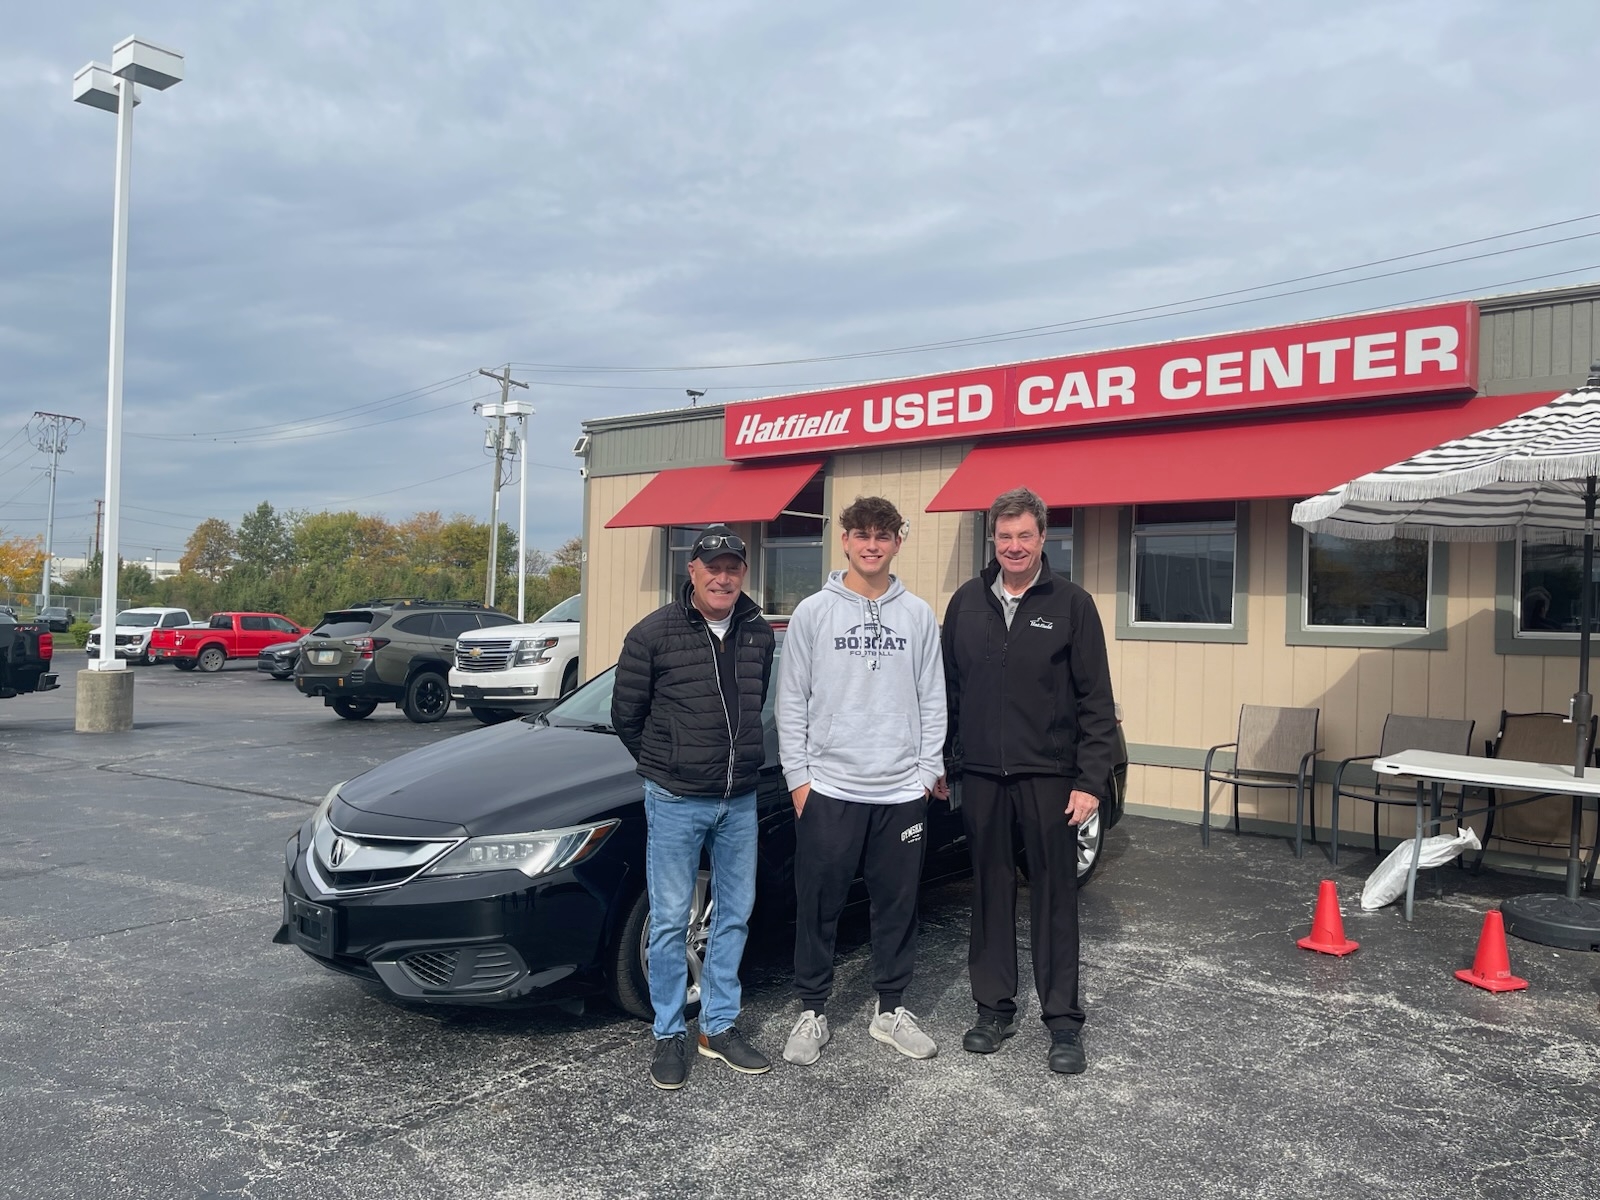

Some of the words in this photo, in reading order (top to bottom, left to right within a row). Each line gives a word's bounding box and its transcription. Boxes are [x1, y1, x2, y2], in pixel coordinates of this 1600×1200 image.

[735, 407, 852, 445] Hatfield
[863, 384, 993, 433] USED
[1017, 365, 1136, 415] CAR
[1159, 325, 1459, 400] CENTER
[834, 636, 907, 651] BOBCAT
